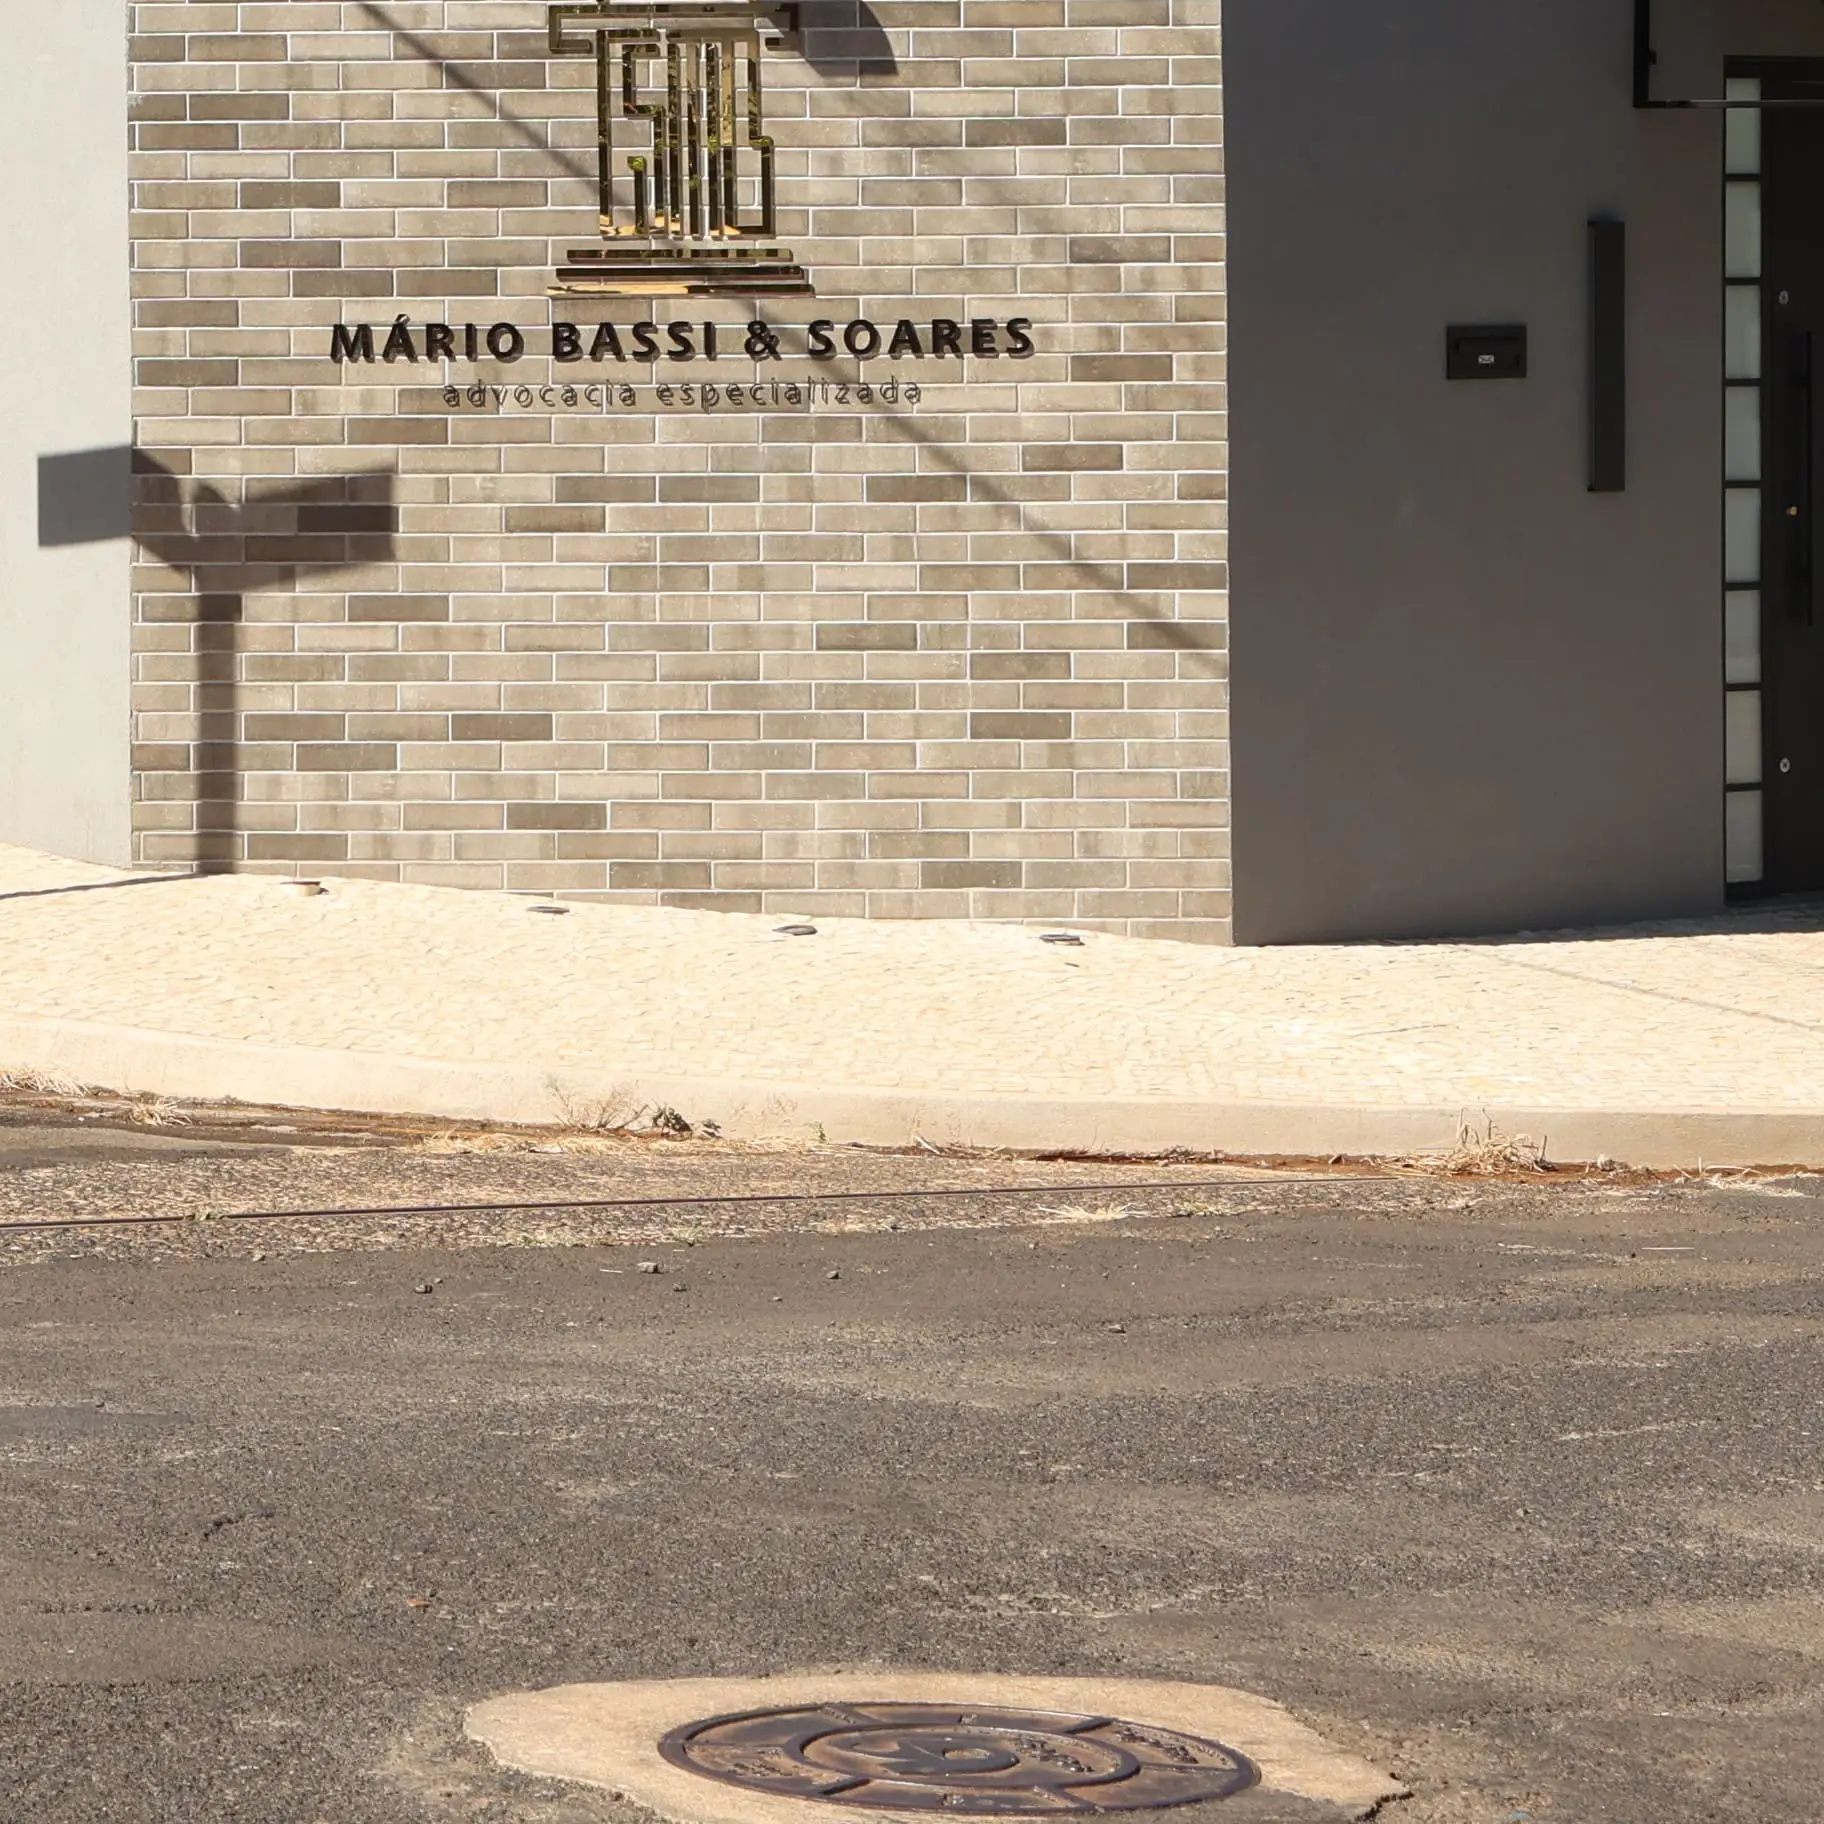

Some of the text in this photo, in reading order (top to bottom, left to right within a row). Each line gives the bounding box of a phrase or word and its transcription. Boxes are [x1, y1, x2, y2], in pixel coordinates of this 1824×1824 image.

[330, 314, 1035, 363] MÁRIO BASSI & SOARES
[443, 377, 922, 414] advocacia especializada
